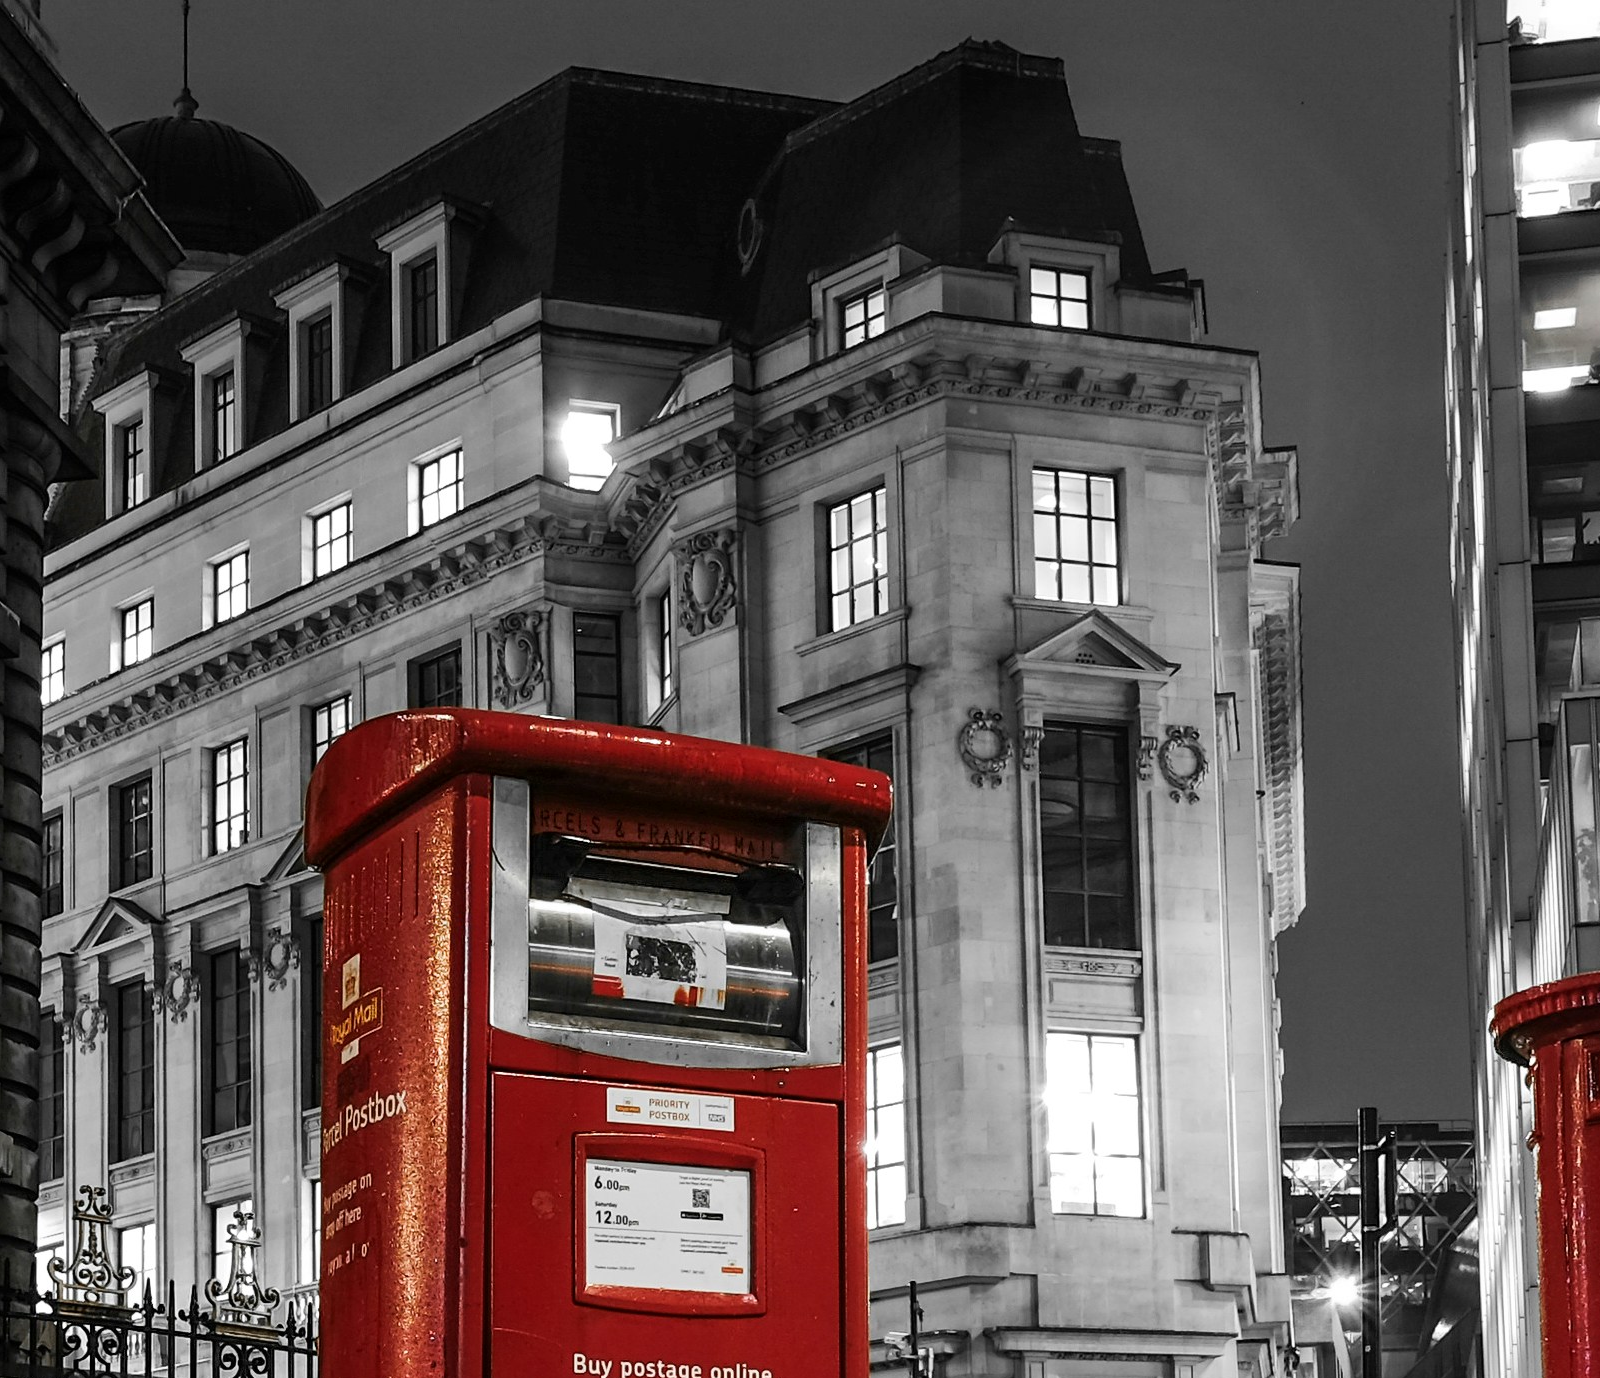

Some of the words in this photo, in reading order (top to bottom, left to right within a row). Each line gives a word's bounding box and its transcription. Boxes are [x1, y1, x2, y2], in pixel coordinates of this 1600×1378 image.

[531, 809, 601, 835] RCELS
[345, 1089, 407, 1136] Postbox
[648, 1098, 690, 1110] PRIORITY
[649, 1110, 690, 1122] POSTBOX
